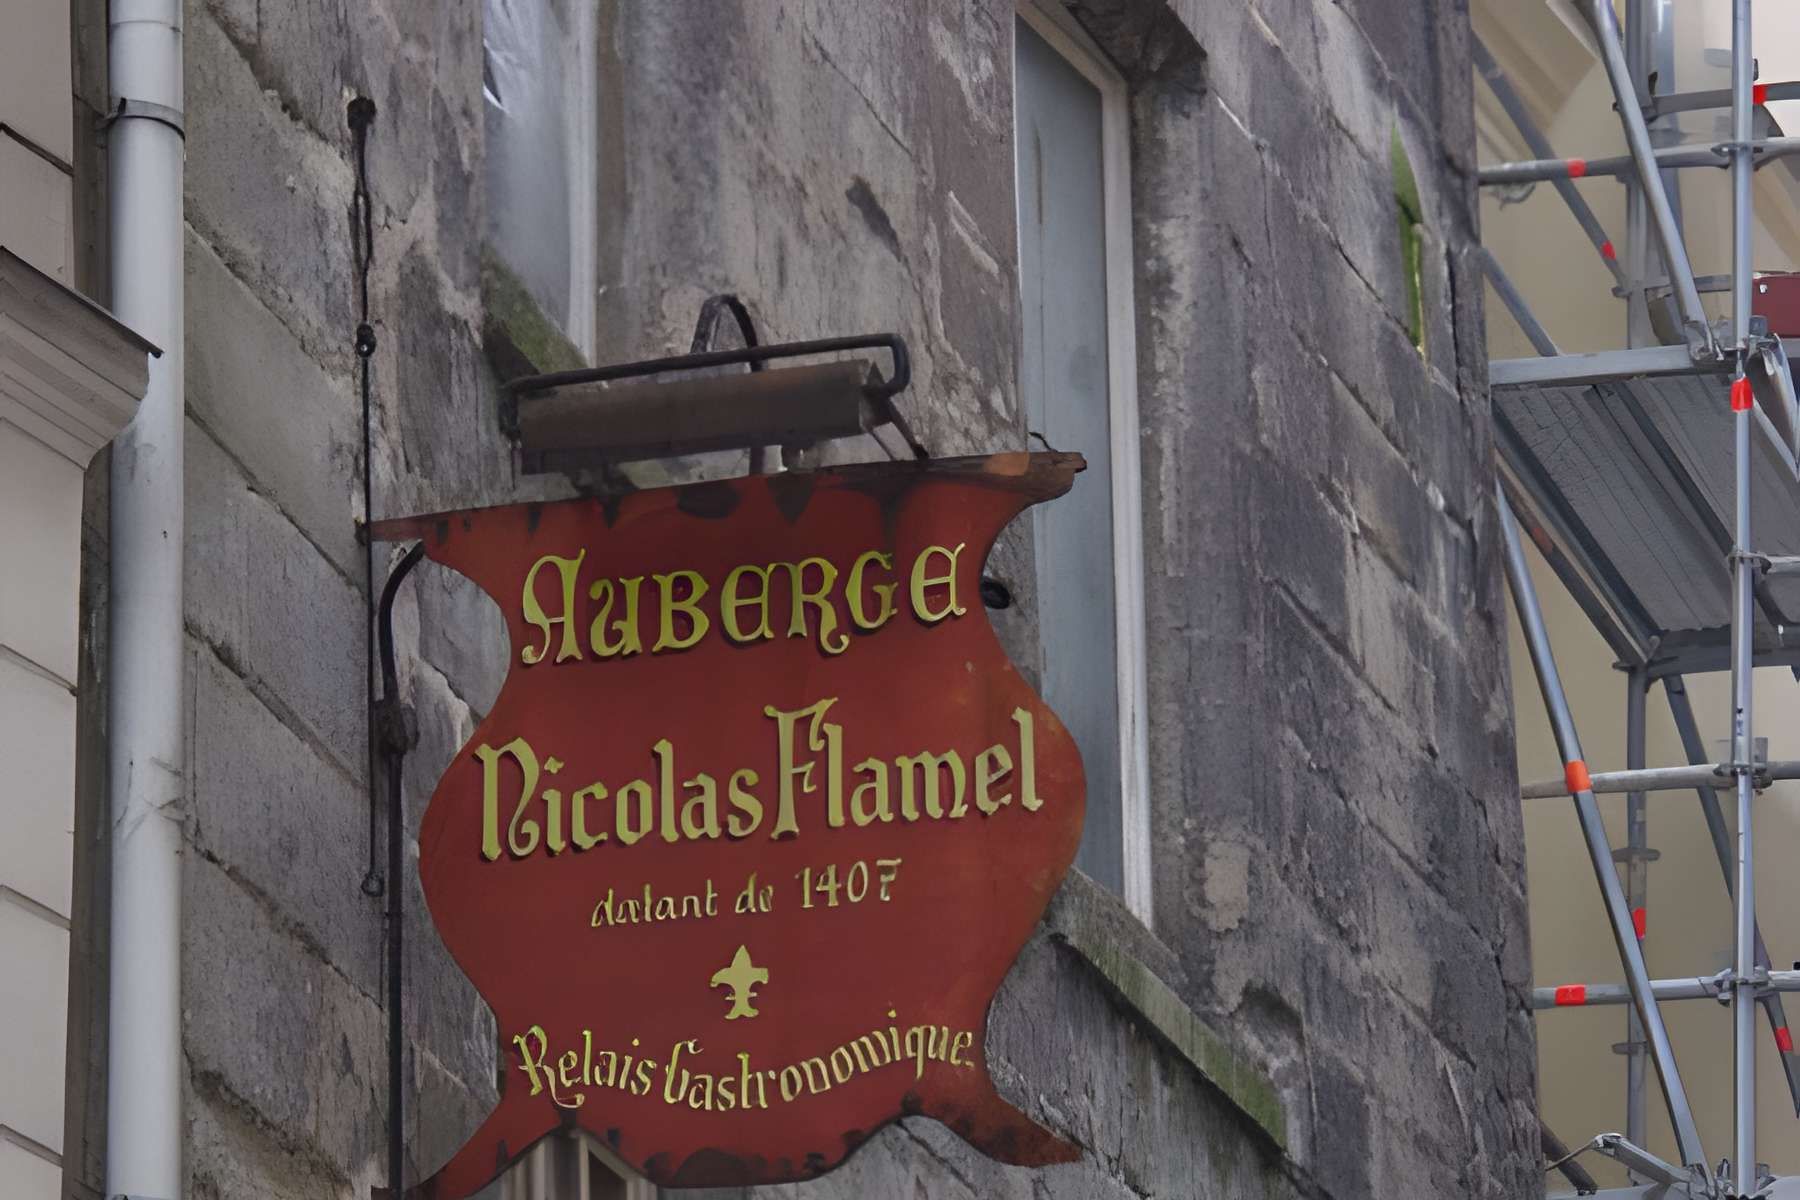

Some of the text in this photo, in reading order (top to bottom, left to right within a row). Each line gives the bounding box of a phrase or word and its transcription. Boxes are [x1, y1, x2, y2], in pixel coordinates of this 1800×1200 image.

[520, 542, 968, 665] AUBERGE
[474, 697, 1044, 861] Nicolas Flamel
[735, 872, 773, 914] de
[795, 858, 902, 909] 1407
[512, 1008, 975, 1112] Relais Gastronomique
